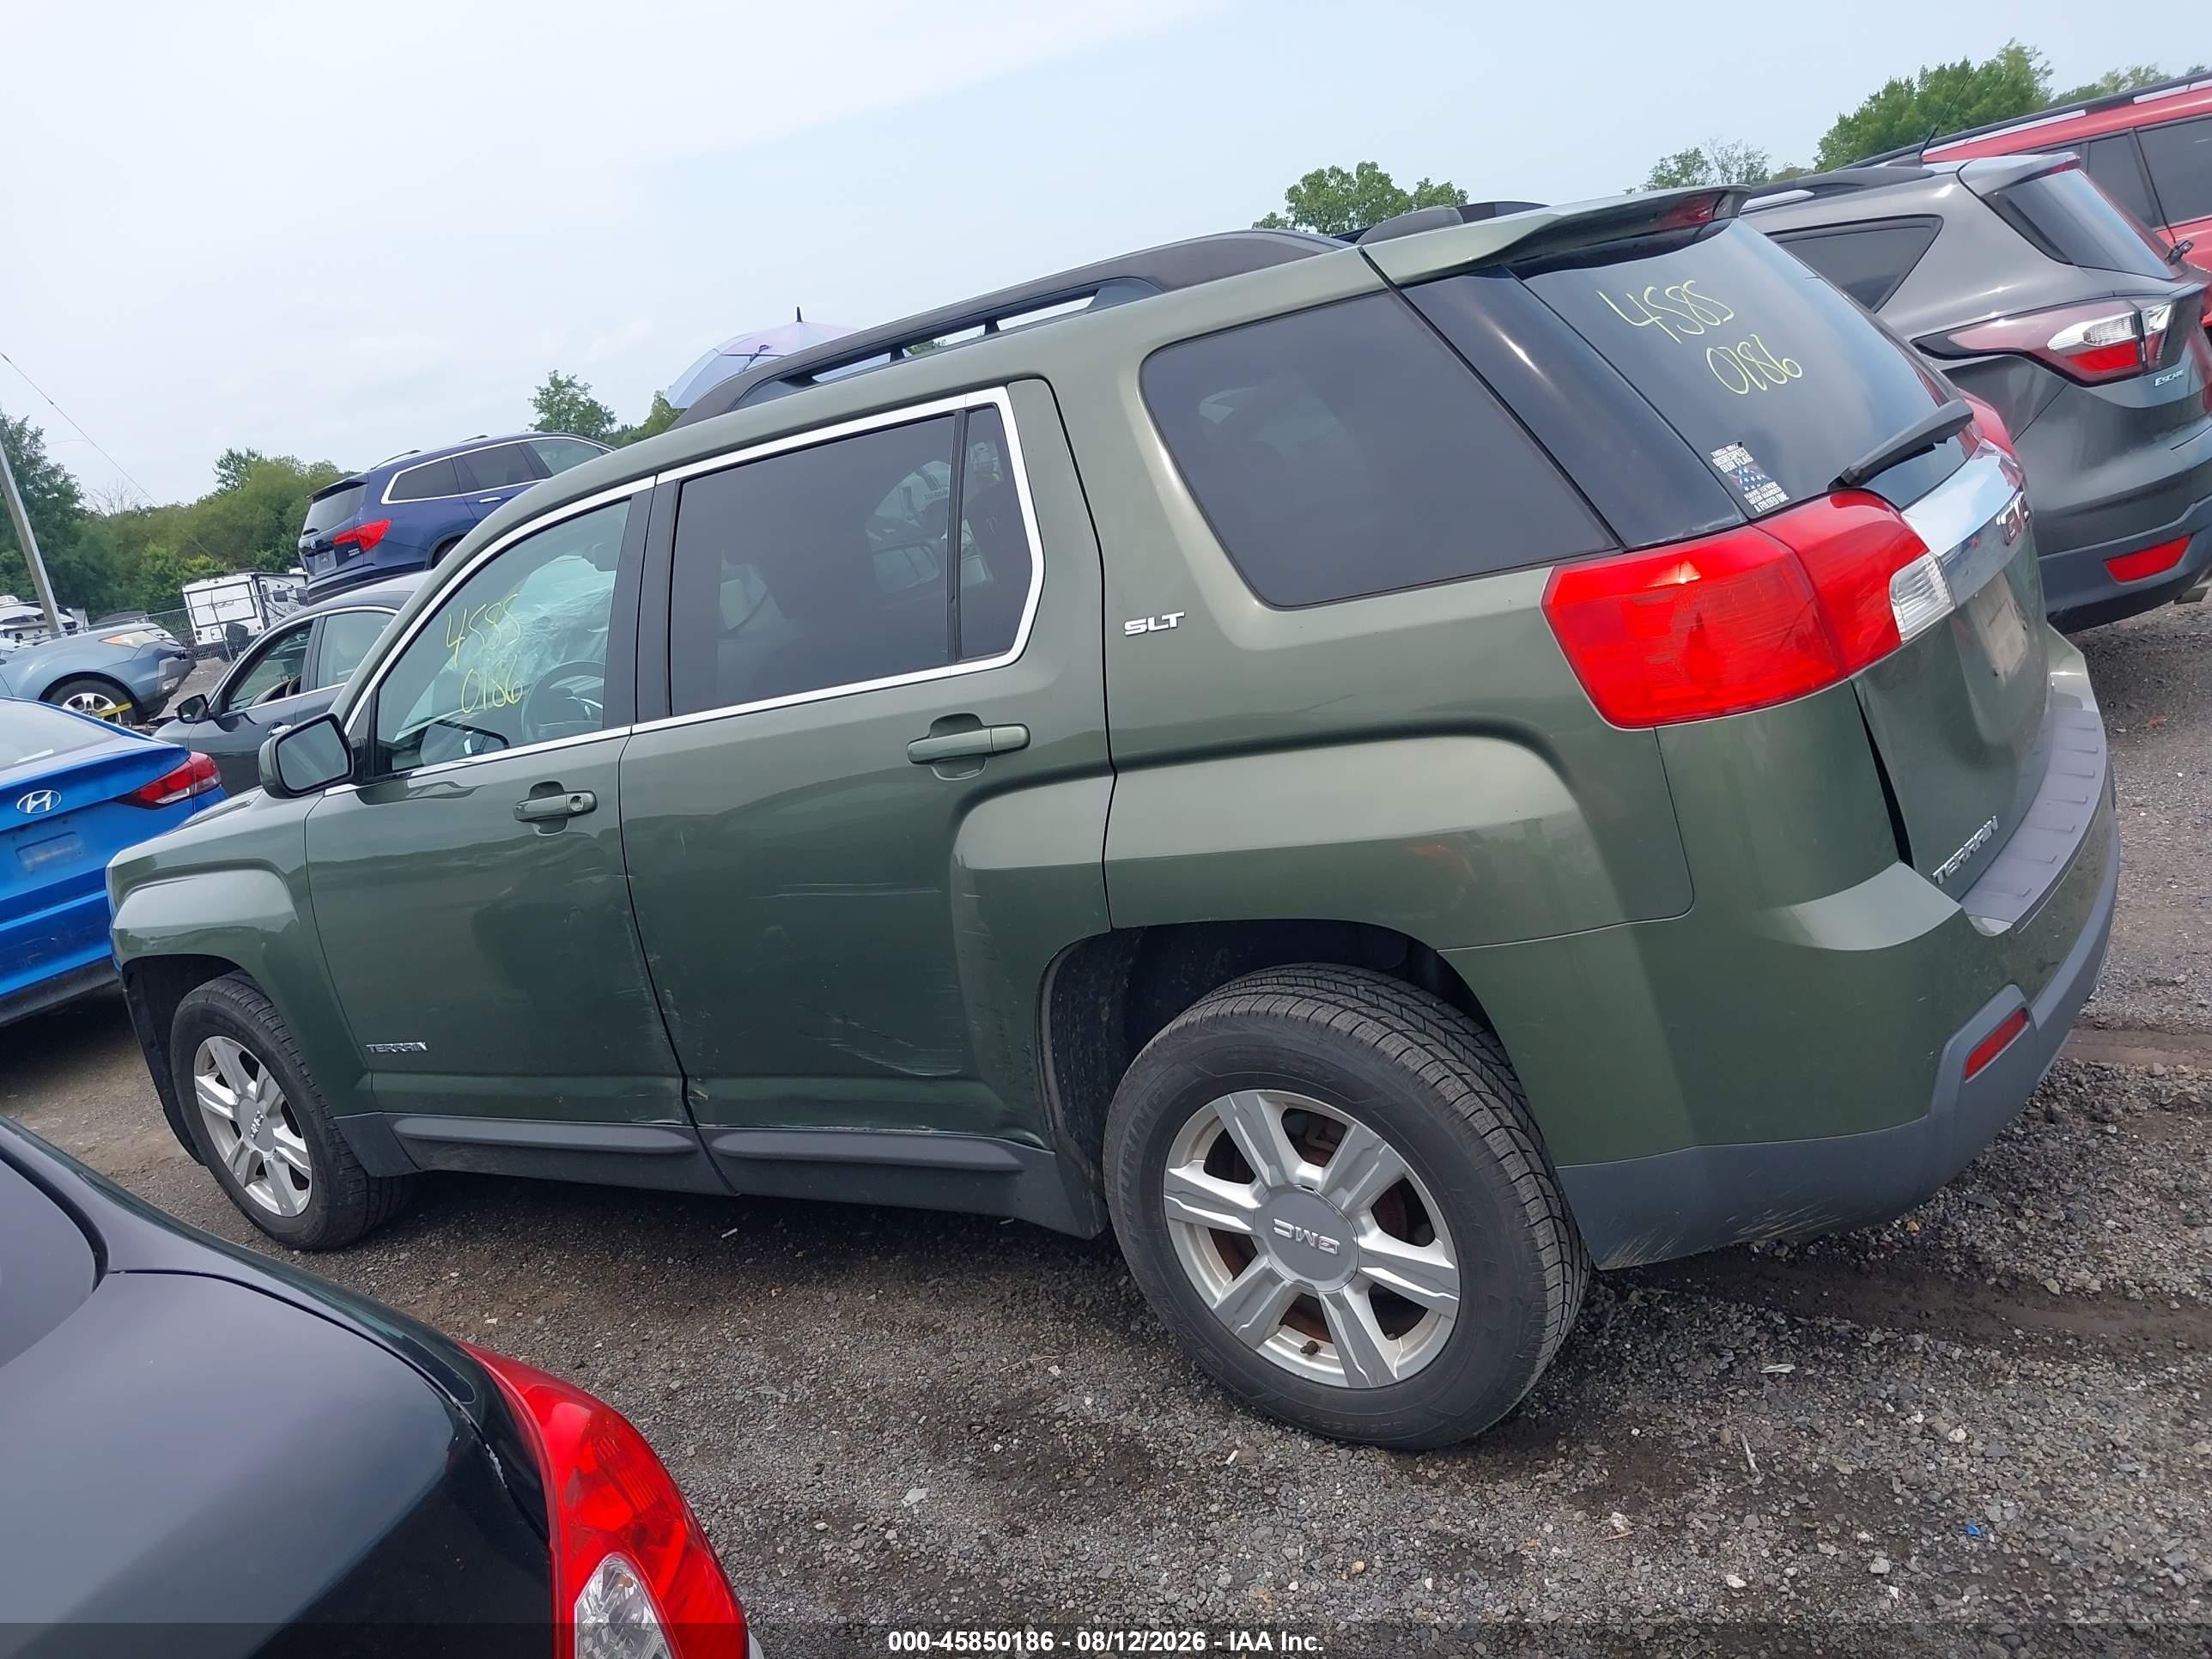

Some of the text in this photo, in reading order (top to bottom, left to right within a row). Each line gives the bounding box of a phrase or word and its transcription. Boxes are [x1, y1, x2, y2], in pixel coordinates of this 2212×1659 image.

[1595, 280, 1735, 343] 4585
[1706, 333, 1802, 395] 0186
[2154, 369, 2185, 386] ESCAPE
[1712, 447, 1748, 466] DISRESPECT
[1719, 454, 1753, 473] OUR FLAG
[1743, 489, 1761, 500] HAVE
[1124, 611, 1185, 636] SLT
[461, 653, 524, 714] 0186
[1931, 815, 1999, 884] TERRAIN
[365, 1042, 428, 1054] TERRAIN
[1273, 1218, 1340, 1255] GMC
